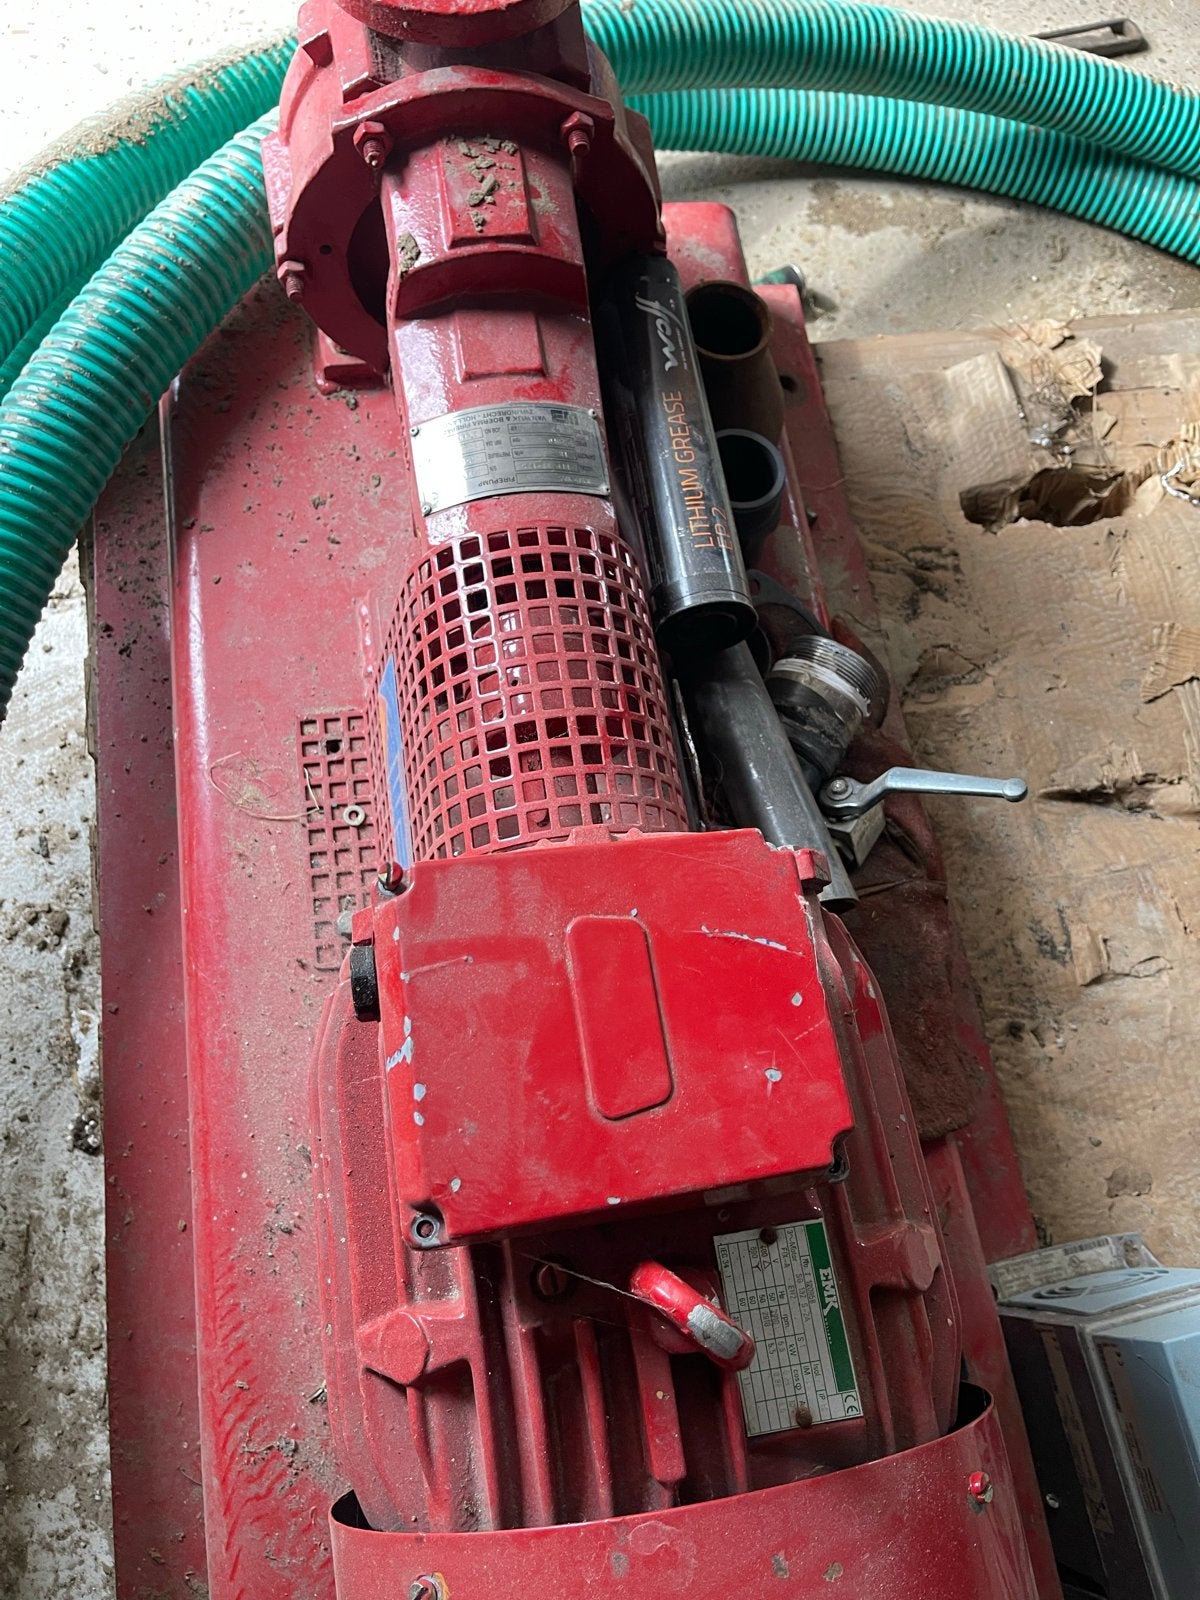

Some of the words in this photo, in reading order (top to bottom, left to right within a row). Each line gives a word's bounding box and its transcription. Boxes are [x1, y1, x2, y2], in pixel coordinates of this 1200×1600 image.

[472, 416, 504, 426] BOERMA
[661, 389, 695, 464] GREASE
[477, 475, 515, 487] FIREPUMP
[677, 467, 714, 550] LITHIUM
[710, 504, 727, 521] 2
[768, 1292, 775, 1301] 50
[818, 1266, 838, 1316] EMK
[738, 1297, 746, 1306] 60
[748, 1295, 756, 1305] 60
[758, 1294, 765, 1303] 50
[782, 1313, 790, 1328] rpm
[788, 1343, 796, 1357] kW
